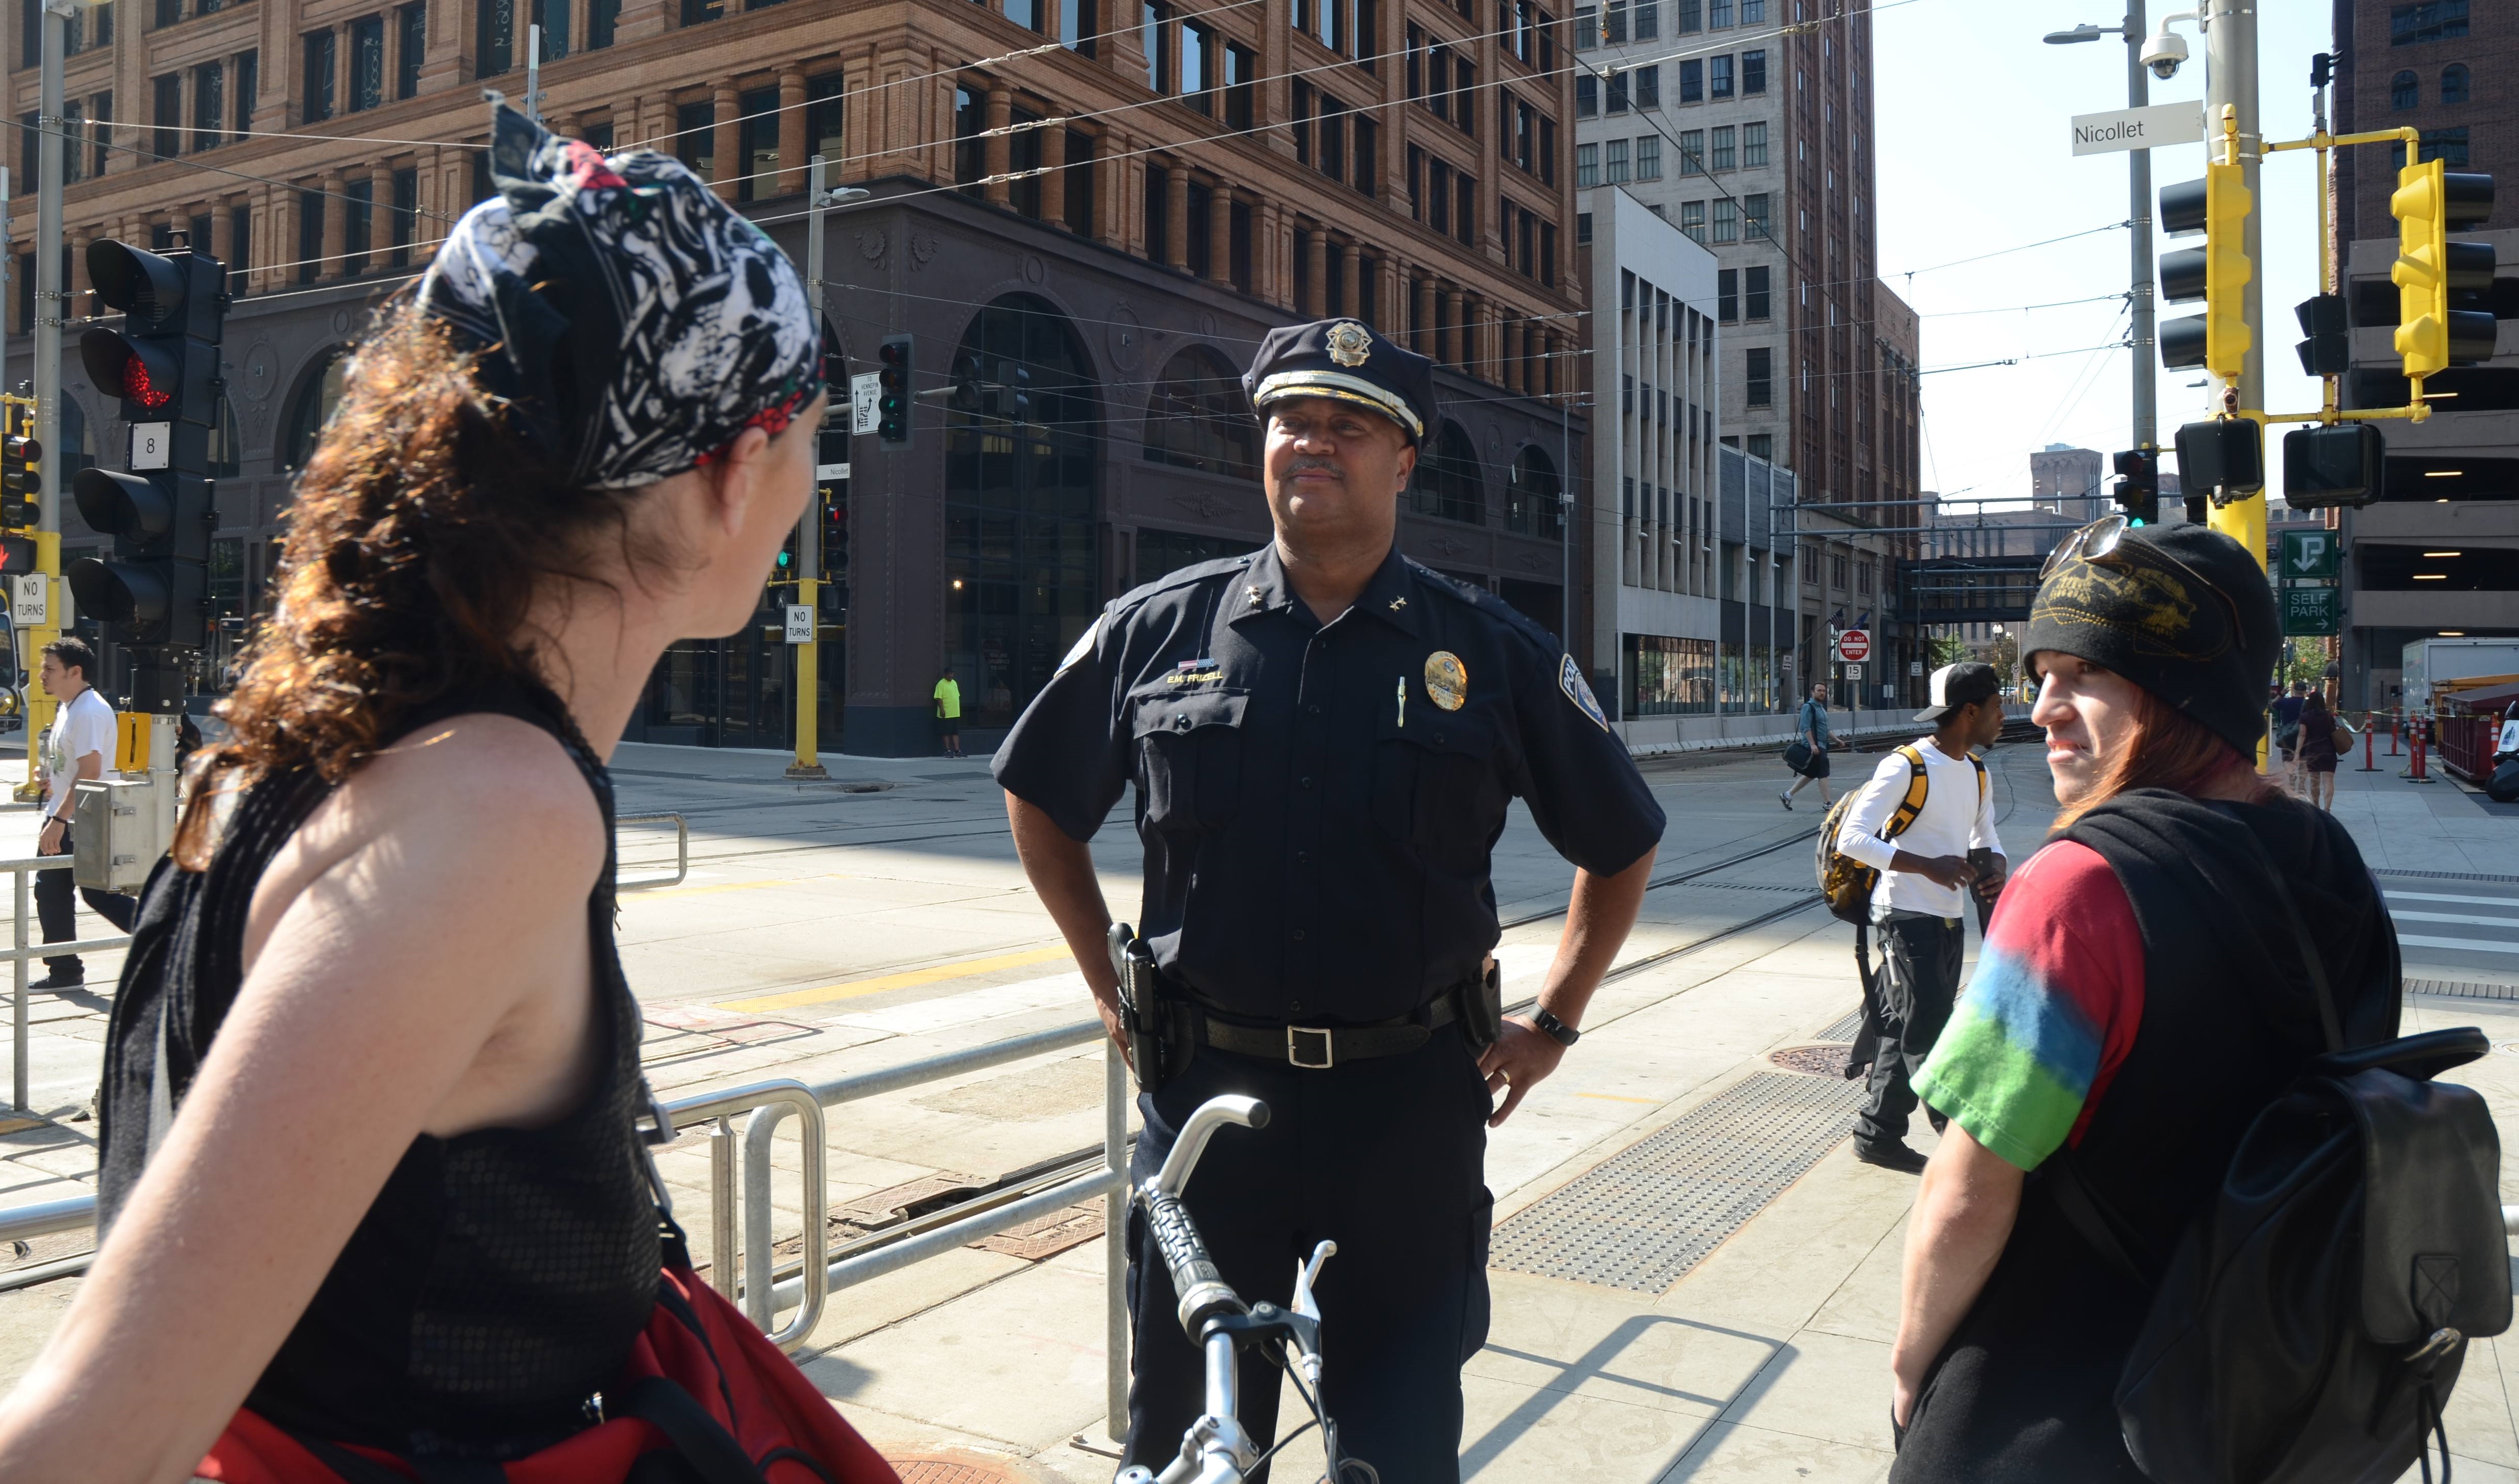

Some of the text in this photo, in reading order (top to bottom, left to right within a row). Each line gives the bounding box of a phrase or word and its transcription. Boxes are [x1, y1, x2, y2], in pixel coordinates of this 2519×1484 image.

[2075, 120, 2144, 144] Nicollet
[861, 382, 878, 390] HENNEPIN
[146, 437, 155, 454] 8
[830, 467, 848, 475] Nicollet
[24, 581, 38, 596] NO
[2291, 593, 2328, 605] SELF
[17, 604, 44, 616] TURNS
[2291, 606, 2329, 617] PARK
[794, 611, 806, 622] NO
[789, 627, 810, 637] TURNS
[1849, 666, 1859, 674] 15
[1187, 671, 1224, 683] FRIZELL
